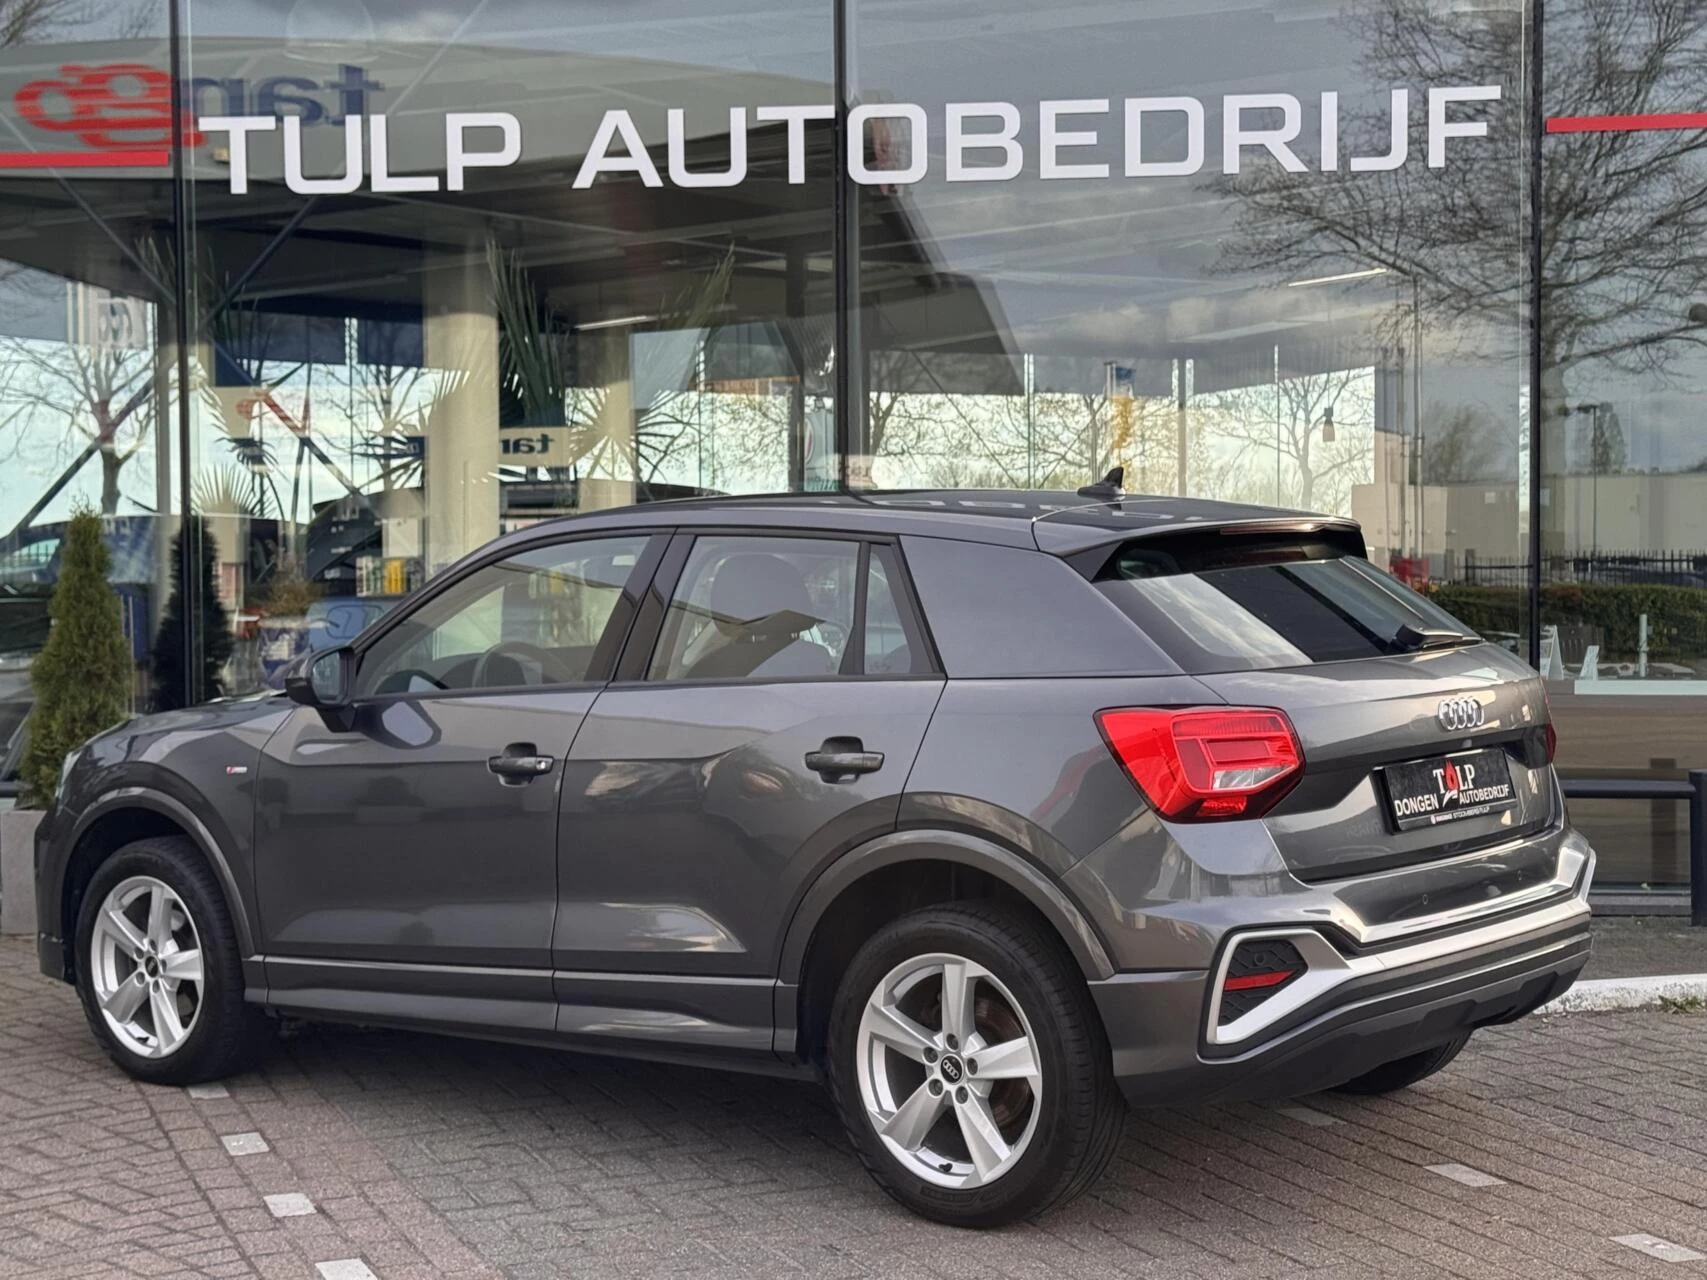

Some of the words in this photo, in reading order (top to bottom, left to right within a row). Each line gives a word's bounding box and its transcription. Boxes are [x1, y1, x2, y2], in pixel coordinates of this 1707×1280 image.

[199, 112, 522, 194] TULP
[571, 85, 1502, 189] AUTOBEDRIJF
[1394, 793, 1440, 817] DONGEN
[1459, 784, 1510, 805] AUTOBEDRIJF
